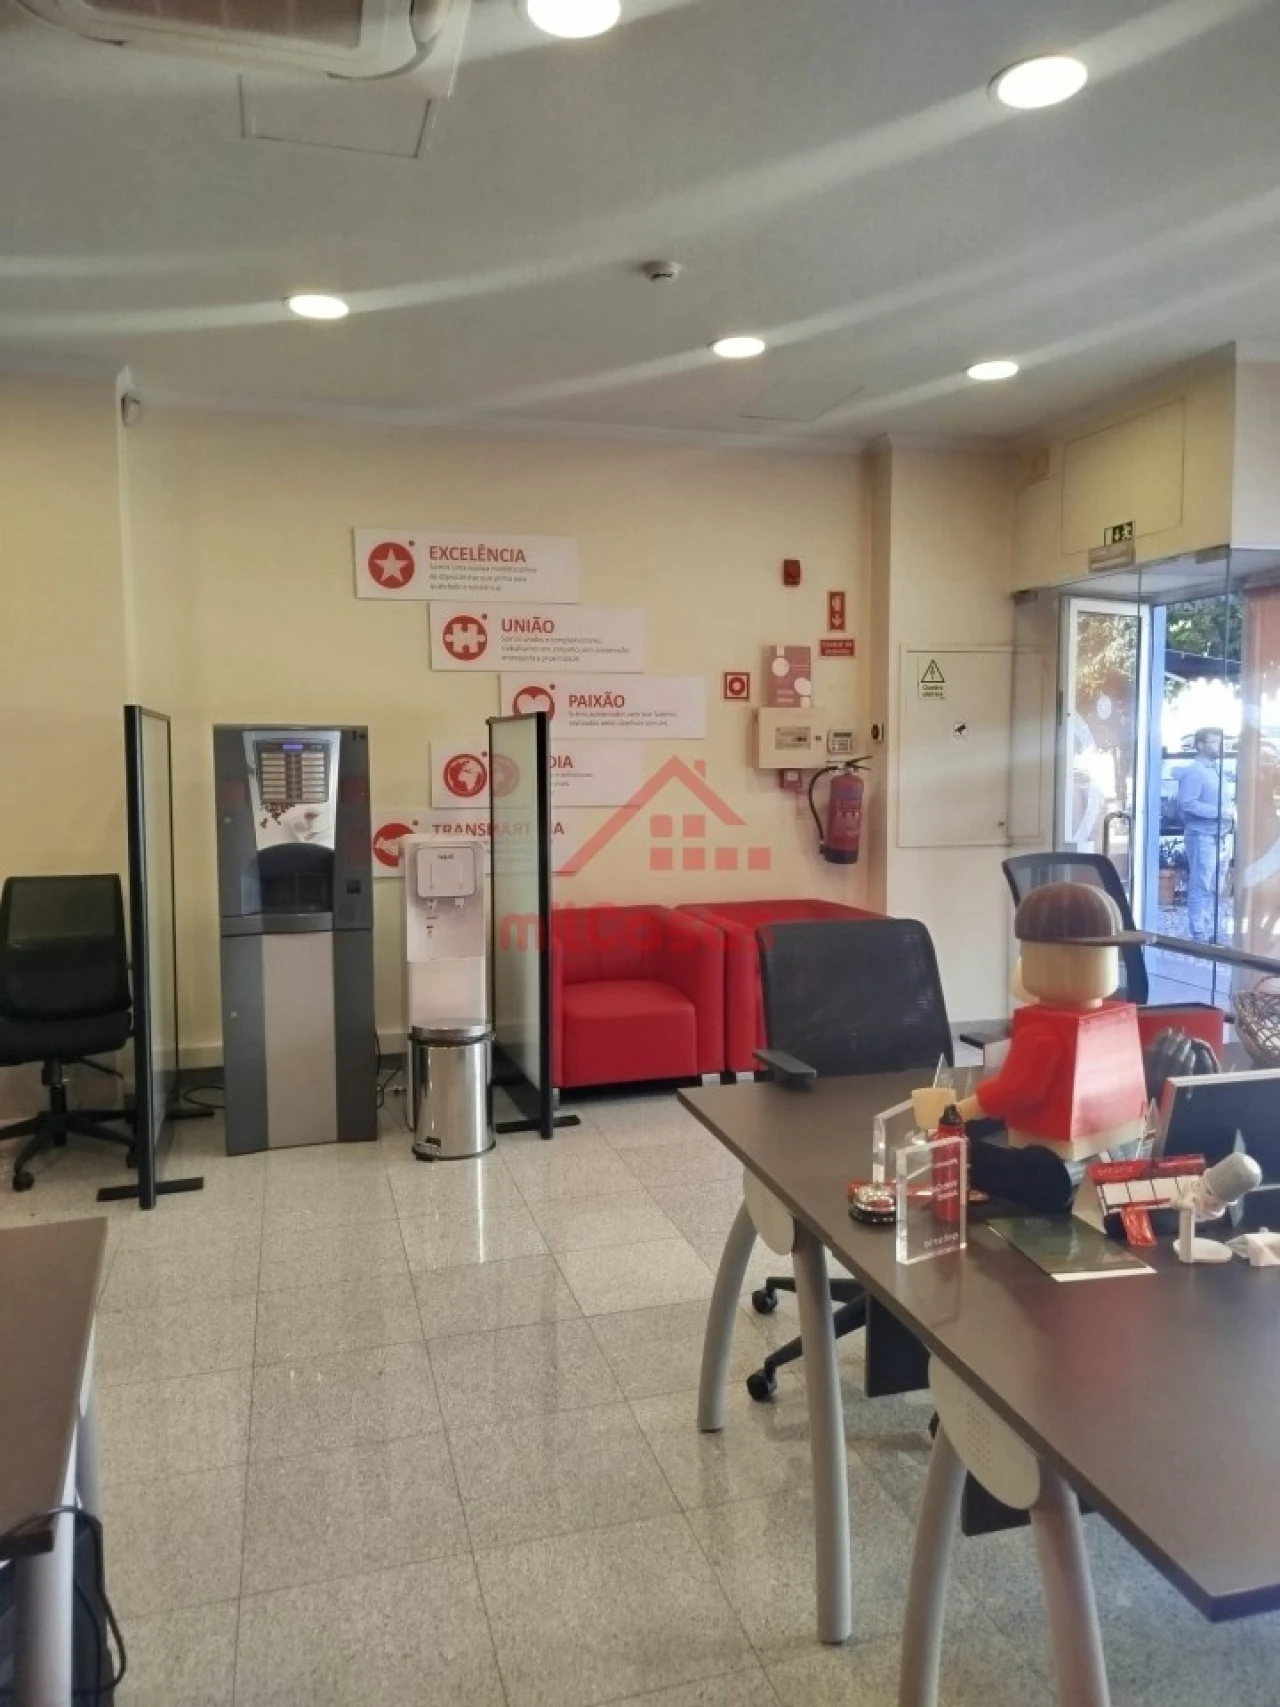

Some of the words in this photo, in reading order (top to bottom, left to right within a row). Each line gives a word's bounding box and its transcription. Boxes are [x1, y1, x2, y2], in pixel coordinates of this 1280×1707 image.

[429, 544, 527, 563] EXCELÊNCIA
[501, 616, 555, 634] UNIÃO
[568, 691, 625, 709] PAIXÃO
